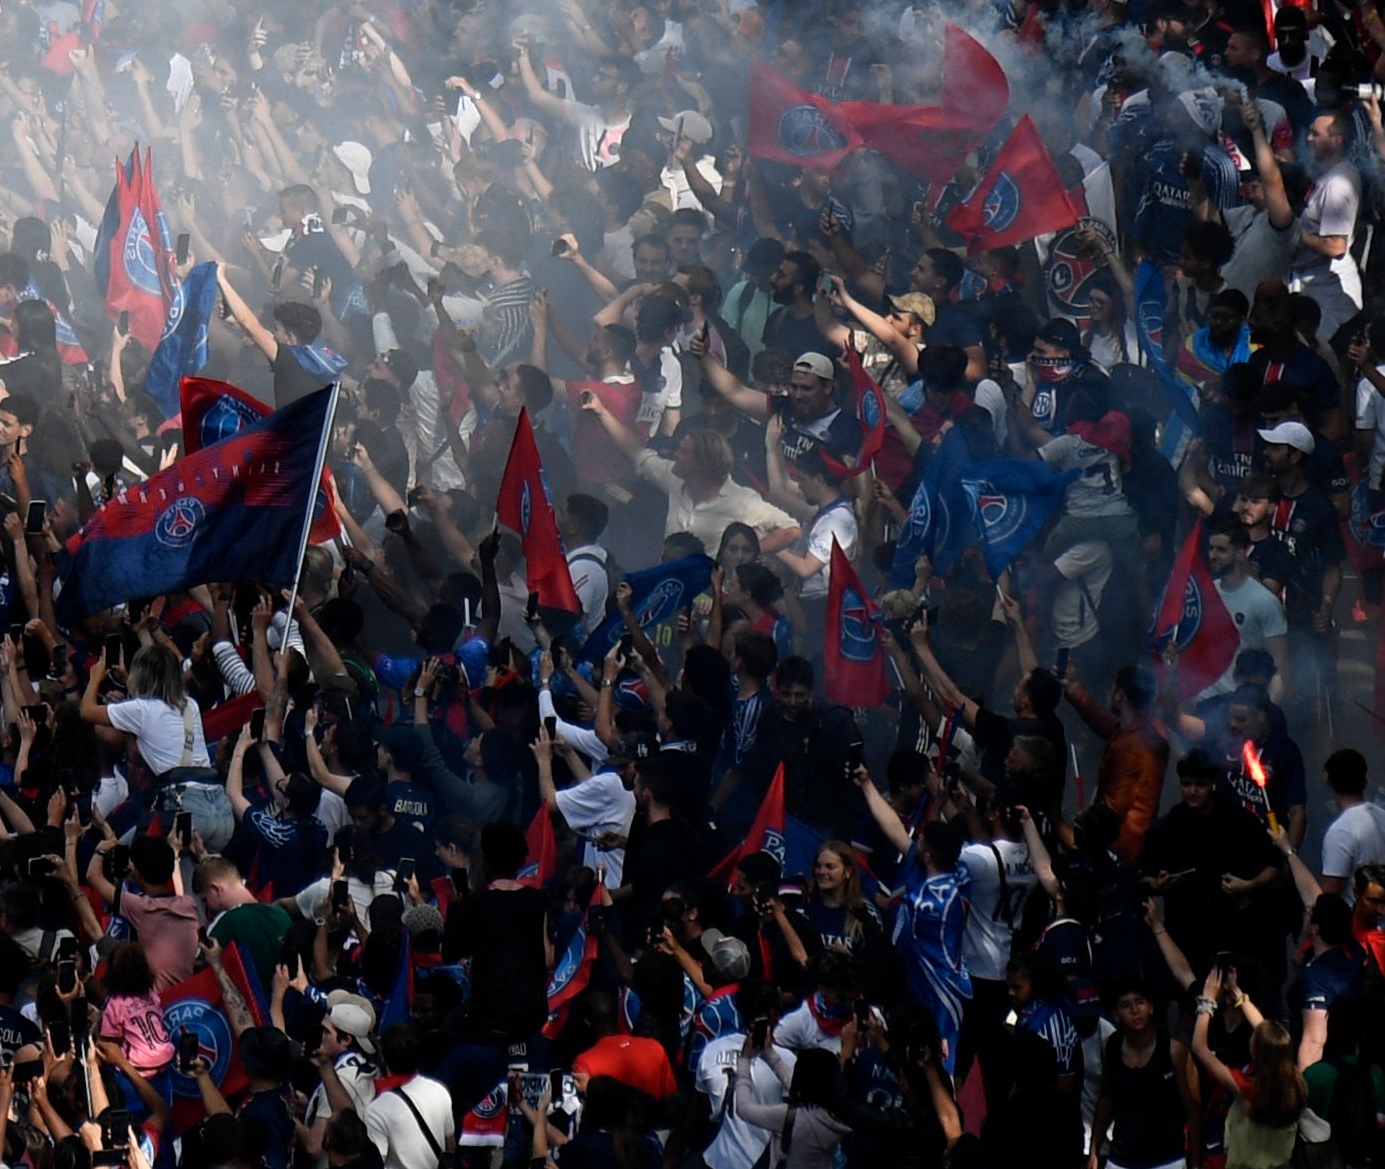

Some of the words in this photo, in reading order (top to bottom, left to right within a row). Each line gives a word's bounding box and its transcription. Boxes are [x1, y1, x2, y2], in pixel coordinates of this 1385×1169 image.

[1183, 584, 1199, 619] RIS
[656, 624, 672, 647] 10
[393, 798, 428, 816] BARCOLA
